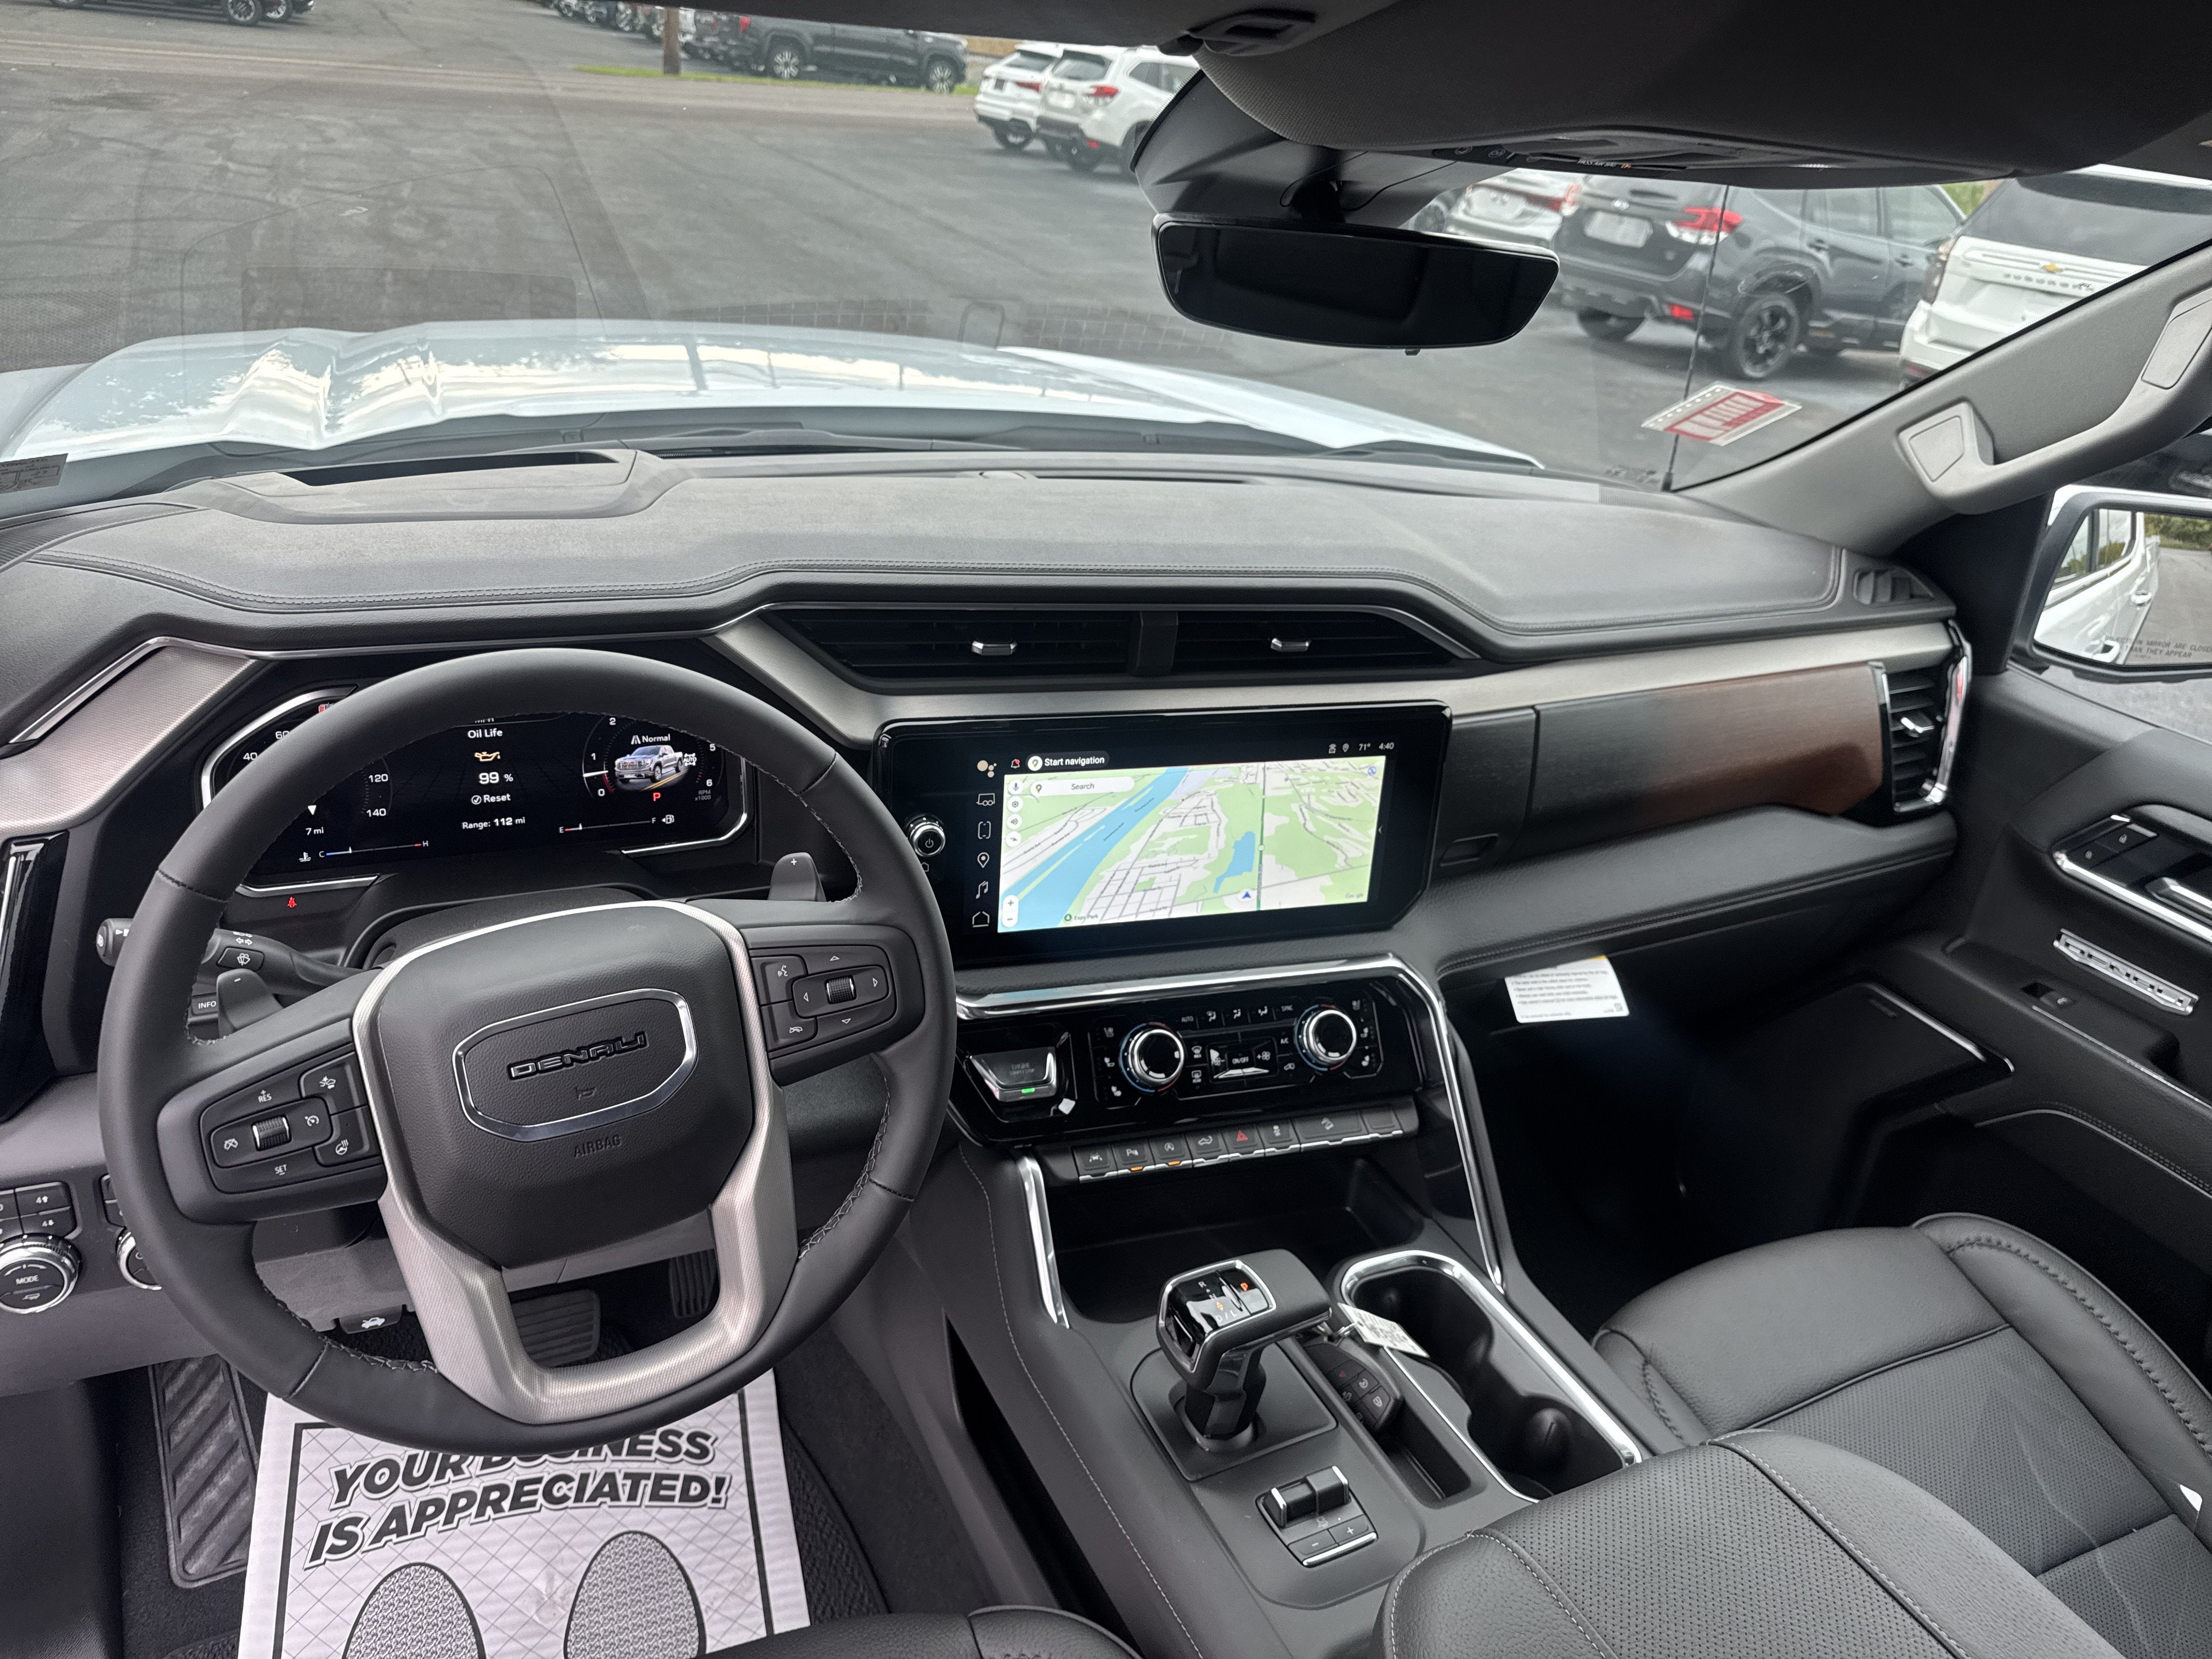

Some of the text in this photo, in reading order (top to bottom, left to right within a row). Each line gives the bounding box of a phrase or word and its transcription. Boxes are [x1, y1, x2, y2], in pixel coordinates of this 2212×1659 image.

[467, 728, 503, 738] Oil Life
[642, 733, 670, 743] Normal
[709, 743, 716, 752] 5
[1379, 742, 1394, 750] 4:40
[243, 752, 258, 761] 40
[1044, 756, 1105, 768] Start navigation
[369, 774, 388, 783] 120
[478, 772, 514, 785] 99 %
[483, 793, 511, 803] Reset
[653, 792, 661, 802] P
[366, 808, 386, 817] 140
[462, 816, 526, 830] Range: 112 mi
[198, 1000, 217, 1009] INFO
[509, 1033, 646, 1079] DENALI
[258, 1093, 272, 1103] RES
[574, 1135, 623, 1158] AIRBAG
[274, 1164, 287, 1175] SET
[15, 1274, 40, 1285] MODE
[331, 1452, 469, 1507] YOUR
[307, 1471, 728, 1565] IS APPRECIATED!
